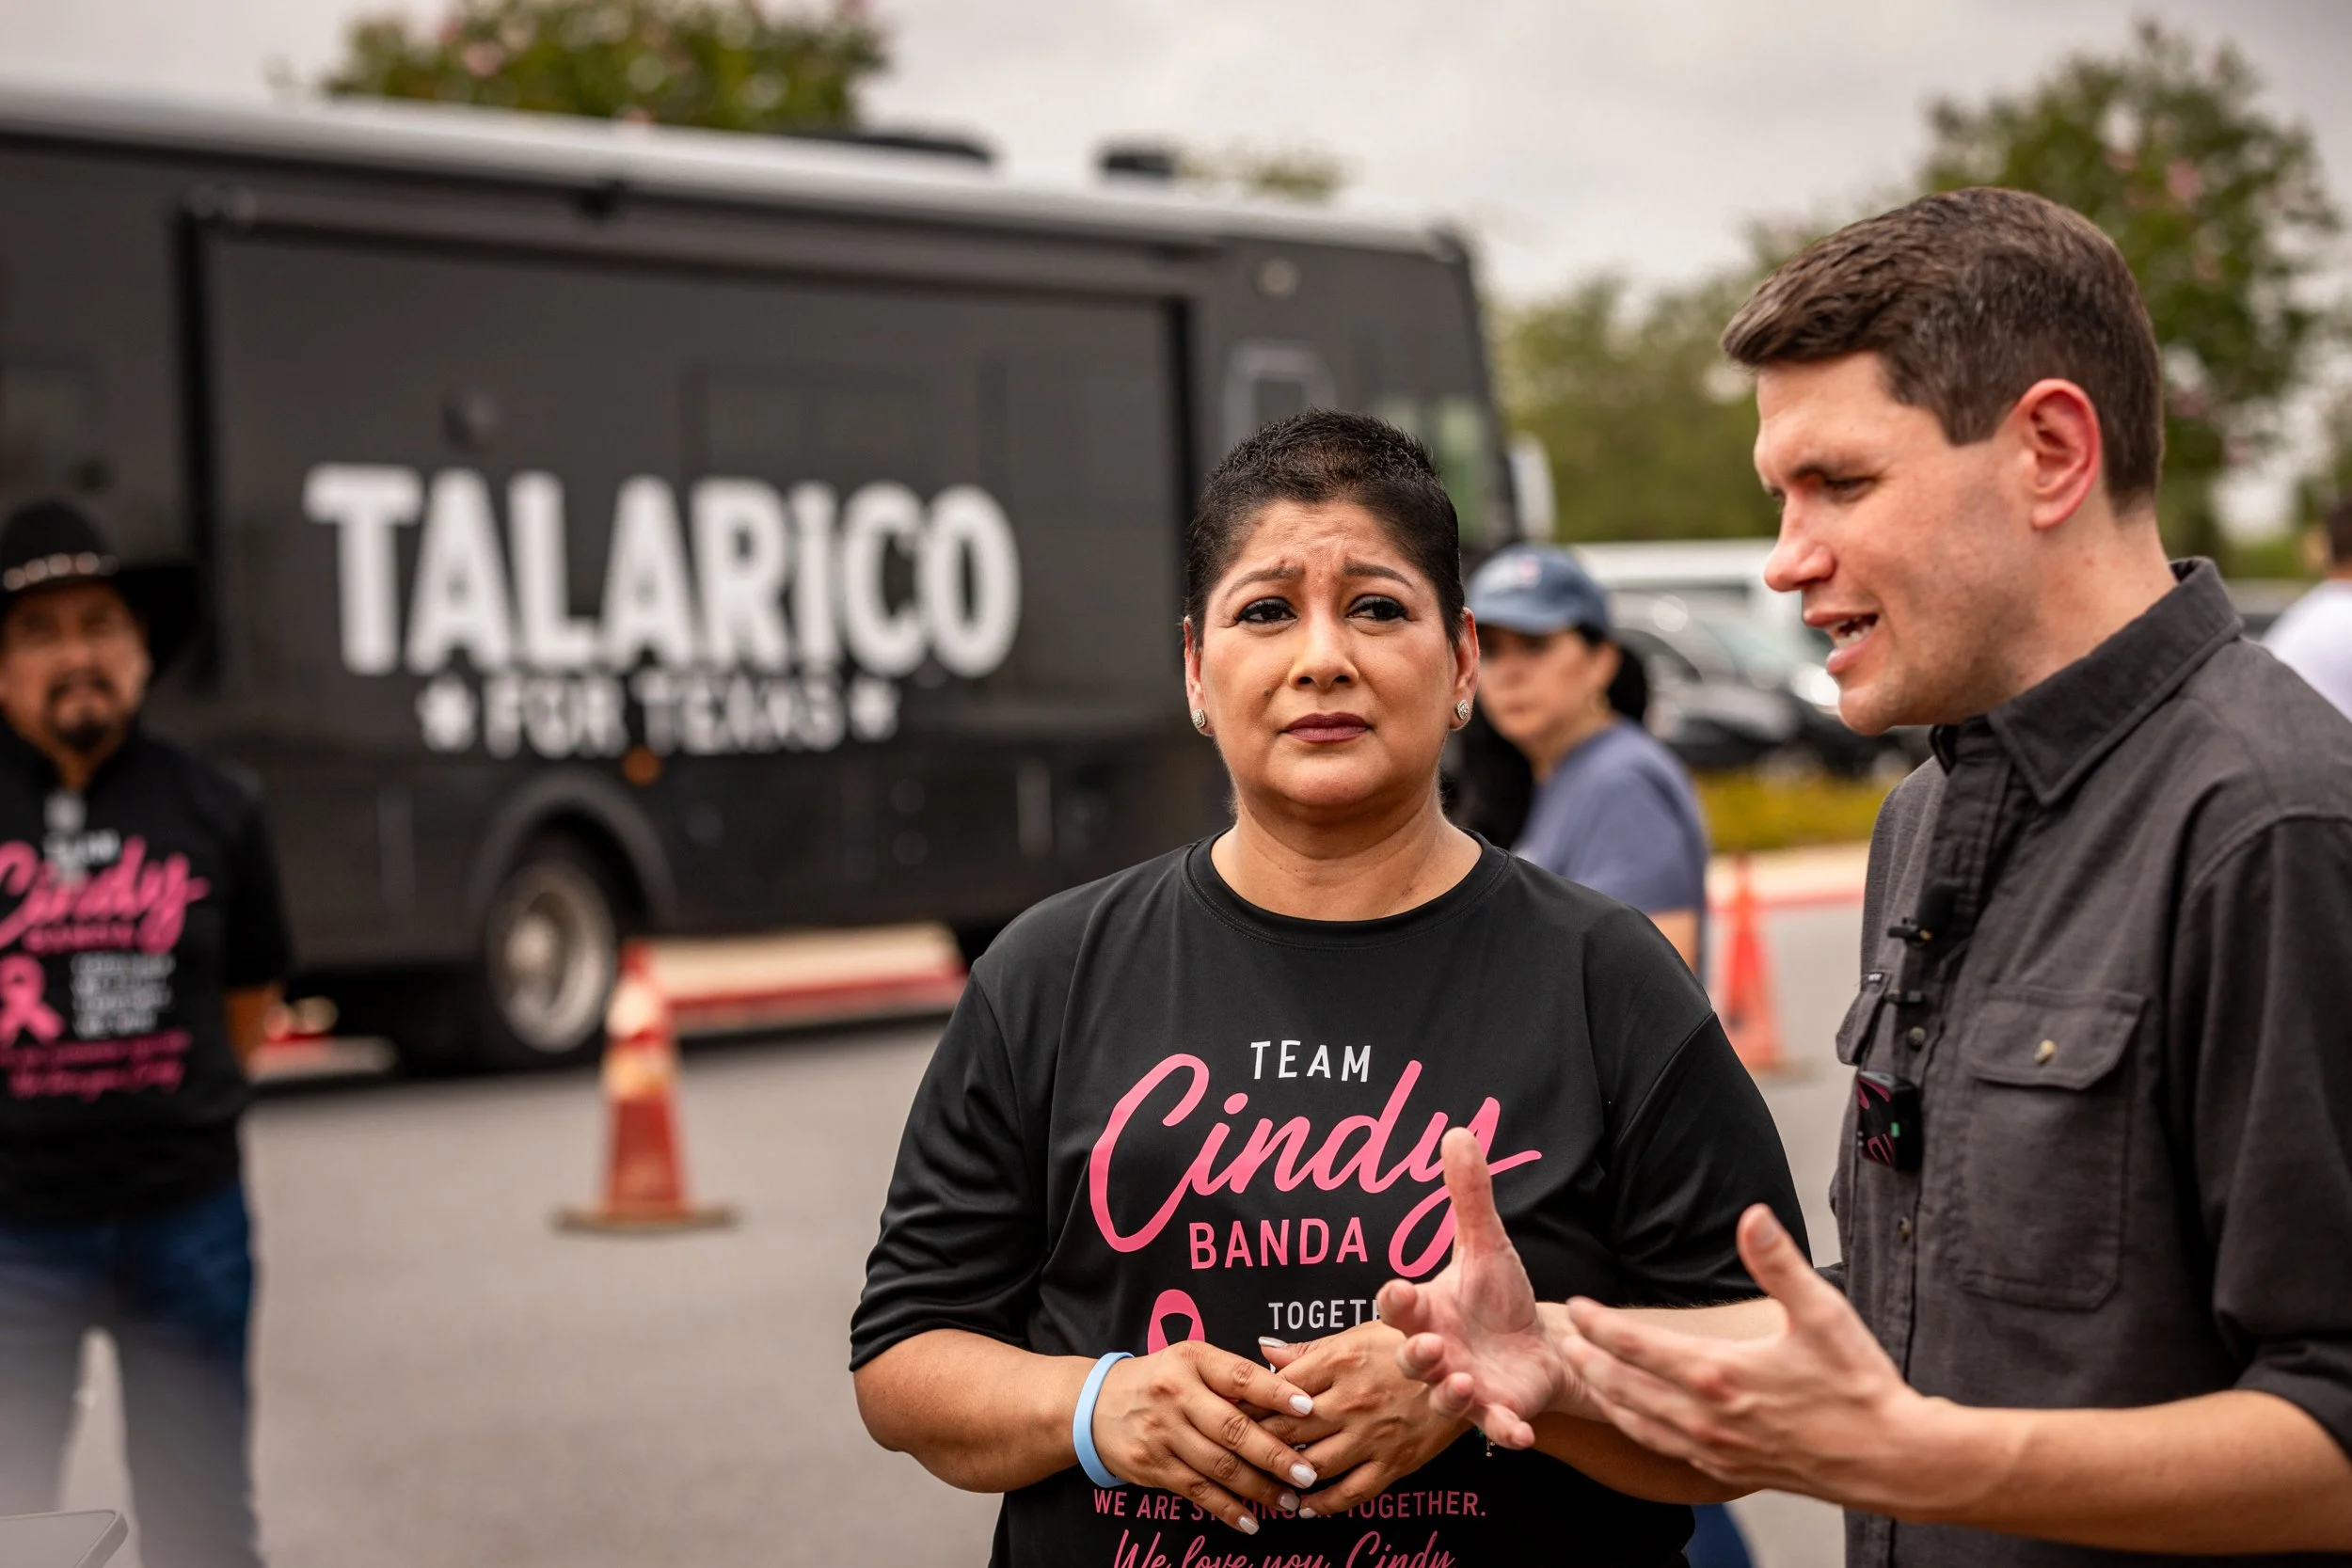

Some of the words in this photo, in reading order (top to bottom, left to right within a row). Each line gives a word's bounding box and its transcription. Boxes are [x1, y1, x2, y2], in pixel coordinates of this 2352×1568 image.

[302, 462, 1022, 679] TALARICO
[485, 673, 628, 758] FOR
[1250, 1039, 1371, 1082] TEAM
[1089, 1053, 1542, 1277] Cindy
[1188, 1217, 1368, 1269] BANDA
[1093, 1489, 1127, 1516] WE
[1136, 1494, 1183, 1521] ARE
